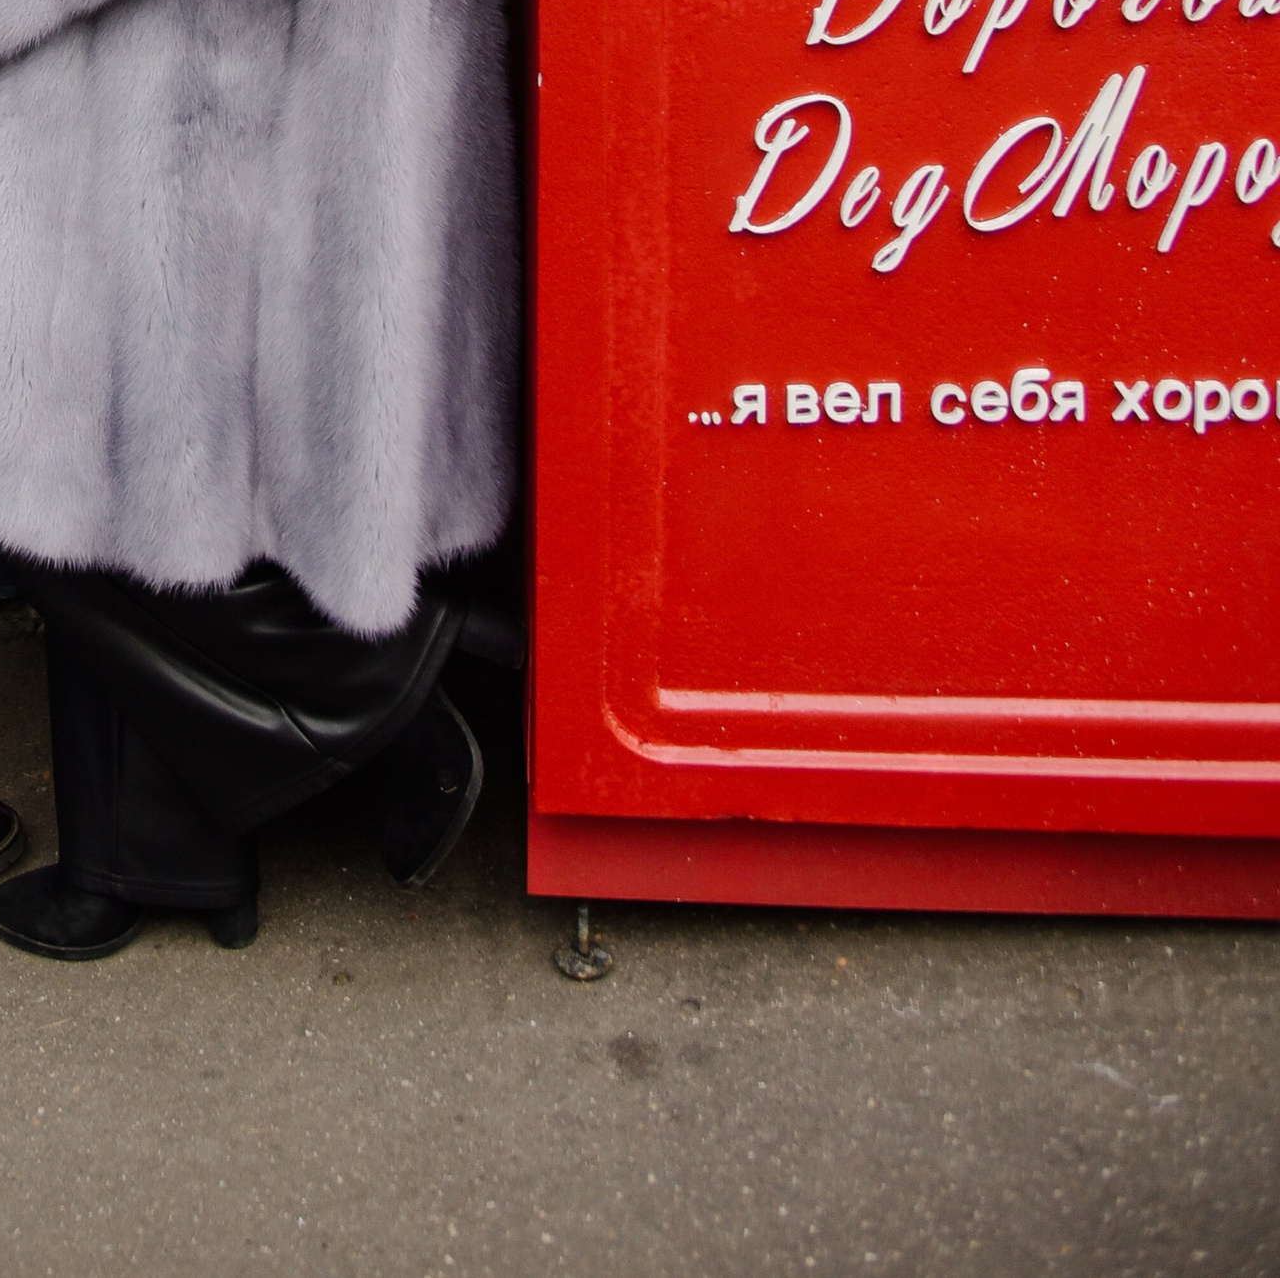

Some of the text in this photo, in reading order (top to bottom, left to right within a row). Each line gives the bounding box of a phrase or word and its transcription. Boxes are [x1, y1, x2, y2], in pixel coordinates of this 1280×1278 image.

[728, 64, 1280, 274] Дед Моро
[785, 381, 903, 425] вел
[929, 367, 1086, 425] себя
[1111, 377, 1280, 435] хоро
